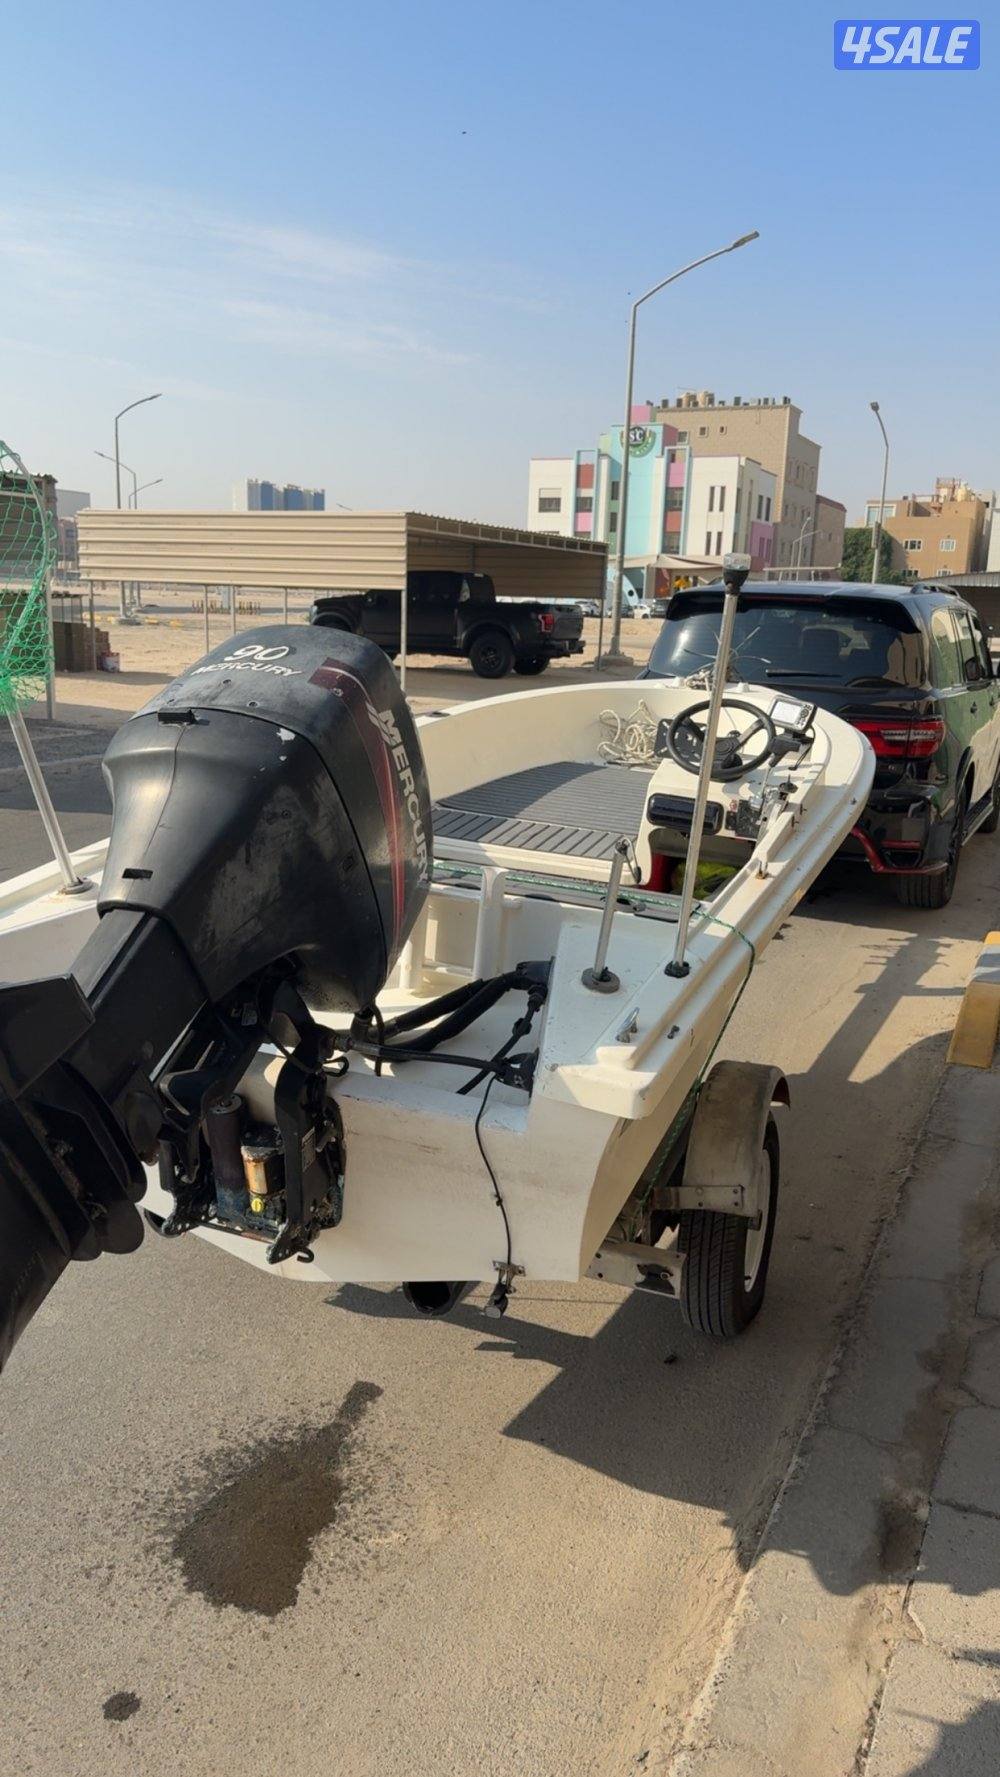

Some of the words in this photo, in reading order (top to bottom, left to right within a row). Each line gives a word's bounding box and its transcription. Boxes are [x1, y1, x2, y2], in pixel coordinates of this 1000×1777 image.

[224, 644, 289, 661] 90
[190, 661, 302, 676] MERCURY
[375, 707, 429, 885] MERCURY
